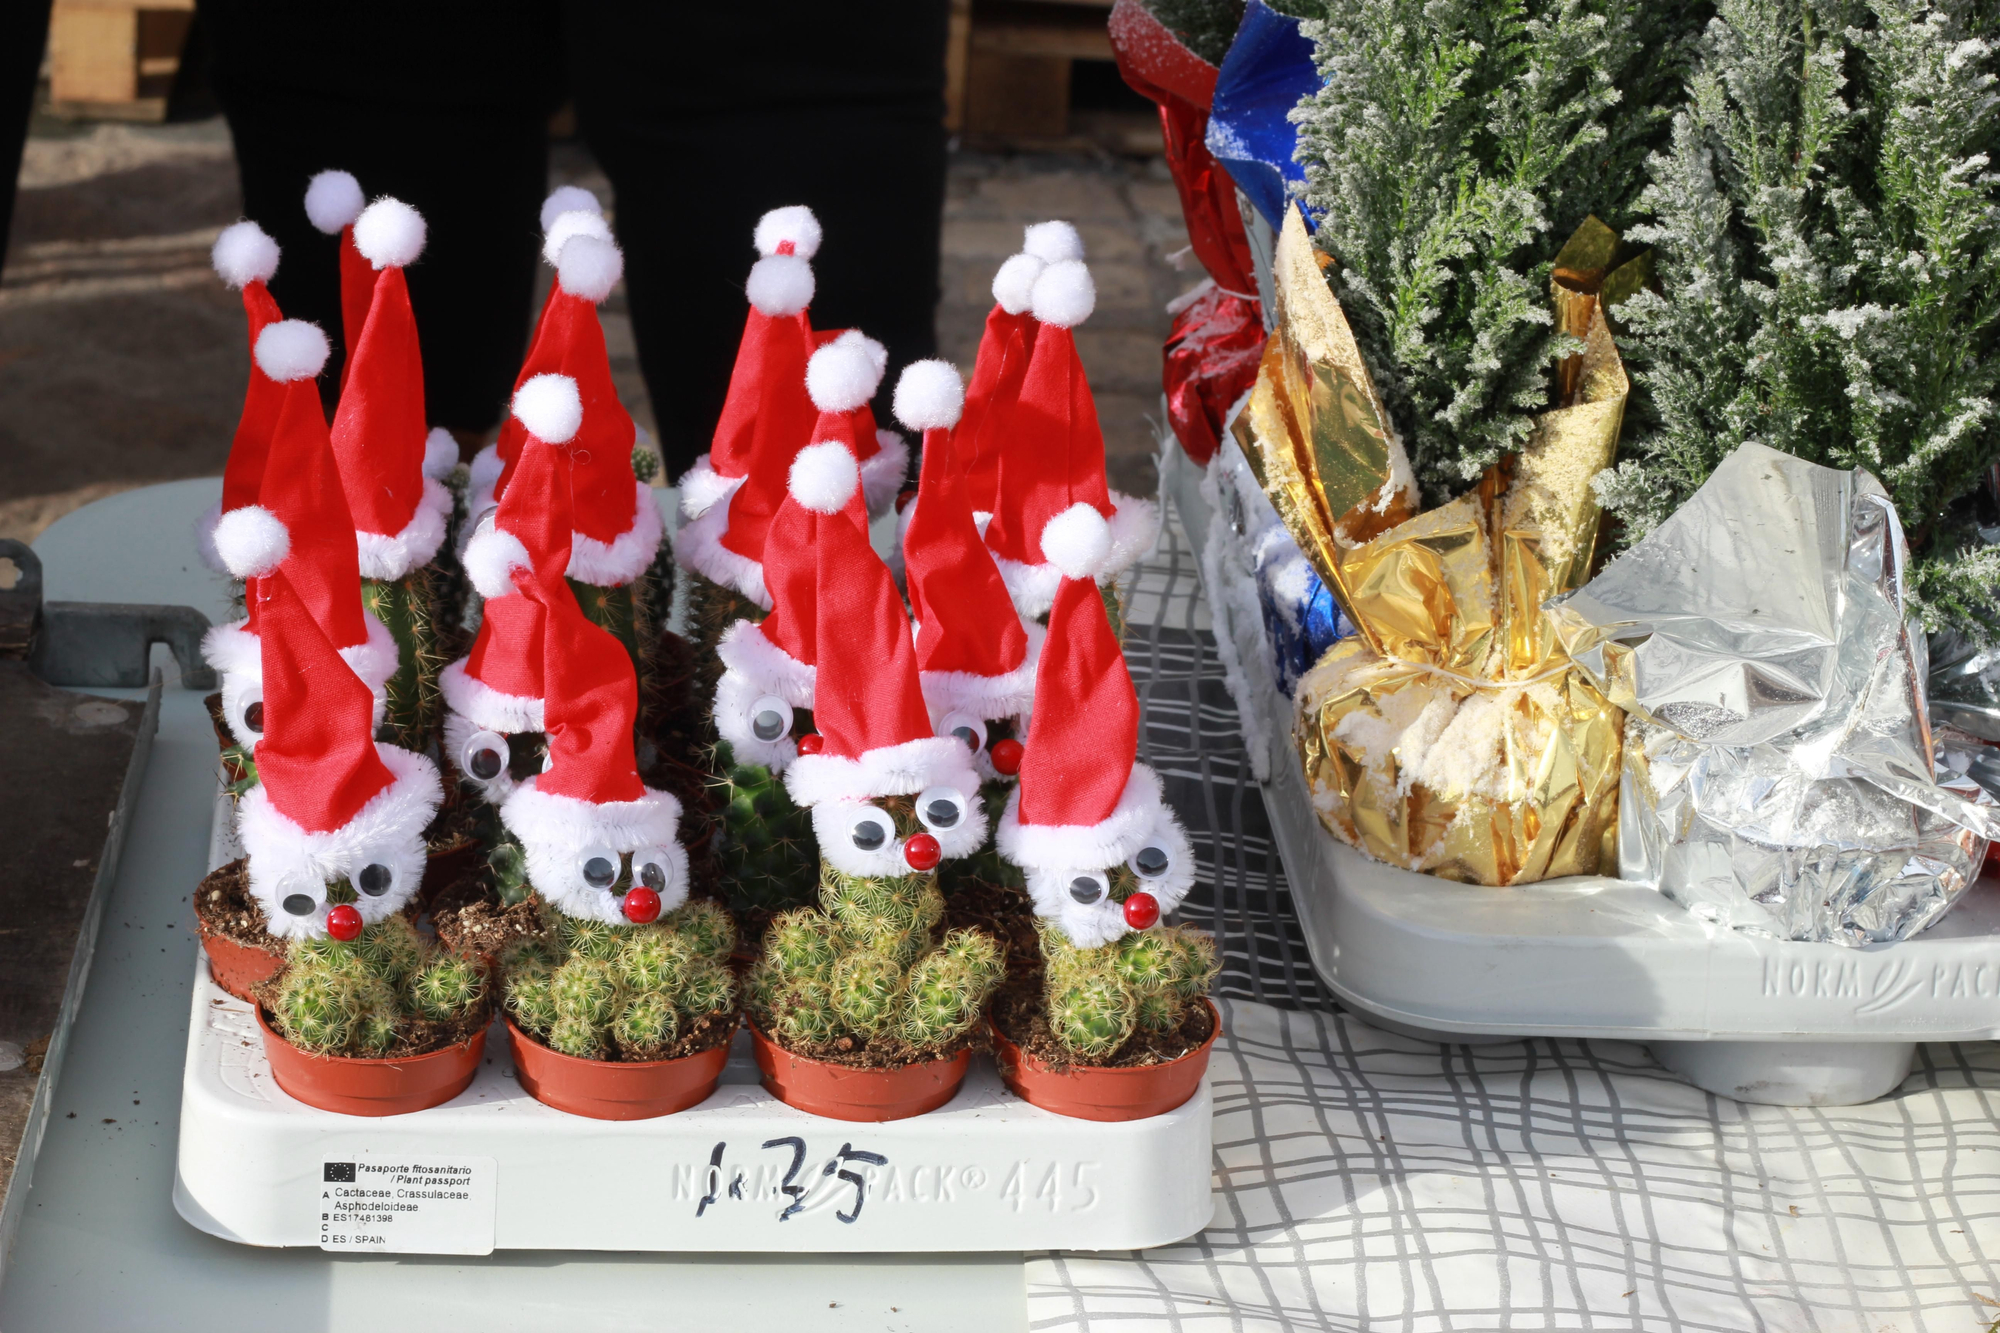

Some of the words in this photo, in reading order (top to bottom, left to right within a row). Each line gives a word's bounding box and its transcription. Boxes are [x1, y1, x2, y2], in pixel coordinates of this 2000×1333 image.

[1762, 956, 1862, 998] NORM
[1931, 961, 2000, 998] PAC
[357, 1163, 410, 1175] Pasaporte
[412, 1164, 472, 1175] fitosanitario
[390, 1175, 396, 1184] /
[396, 1175, 423, 1185] Plant
[424, 1176, 471, 1187] passport
[671, 1163, 784, 1202] NORM
[1000, 1160, 1102, 1214] 445
[322, 1191, 330, 1200] A
[322, 1213, 329, 1221] B
[321, 1223, 329, 1232] C
[321, 1235, 329, 1243] D
[332, 1235, 347, 1244] ES
[355, 1236, 386, 1244] SPAIN
